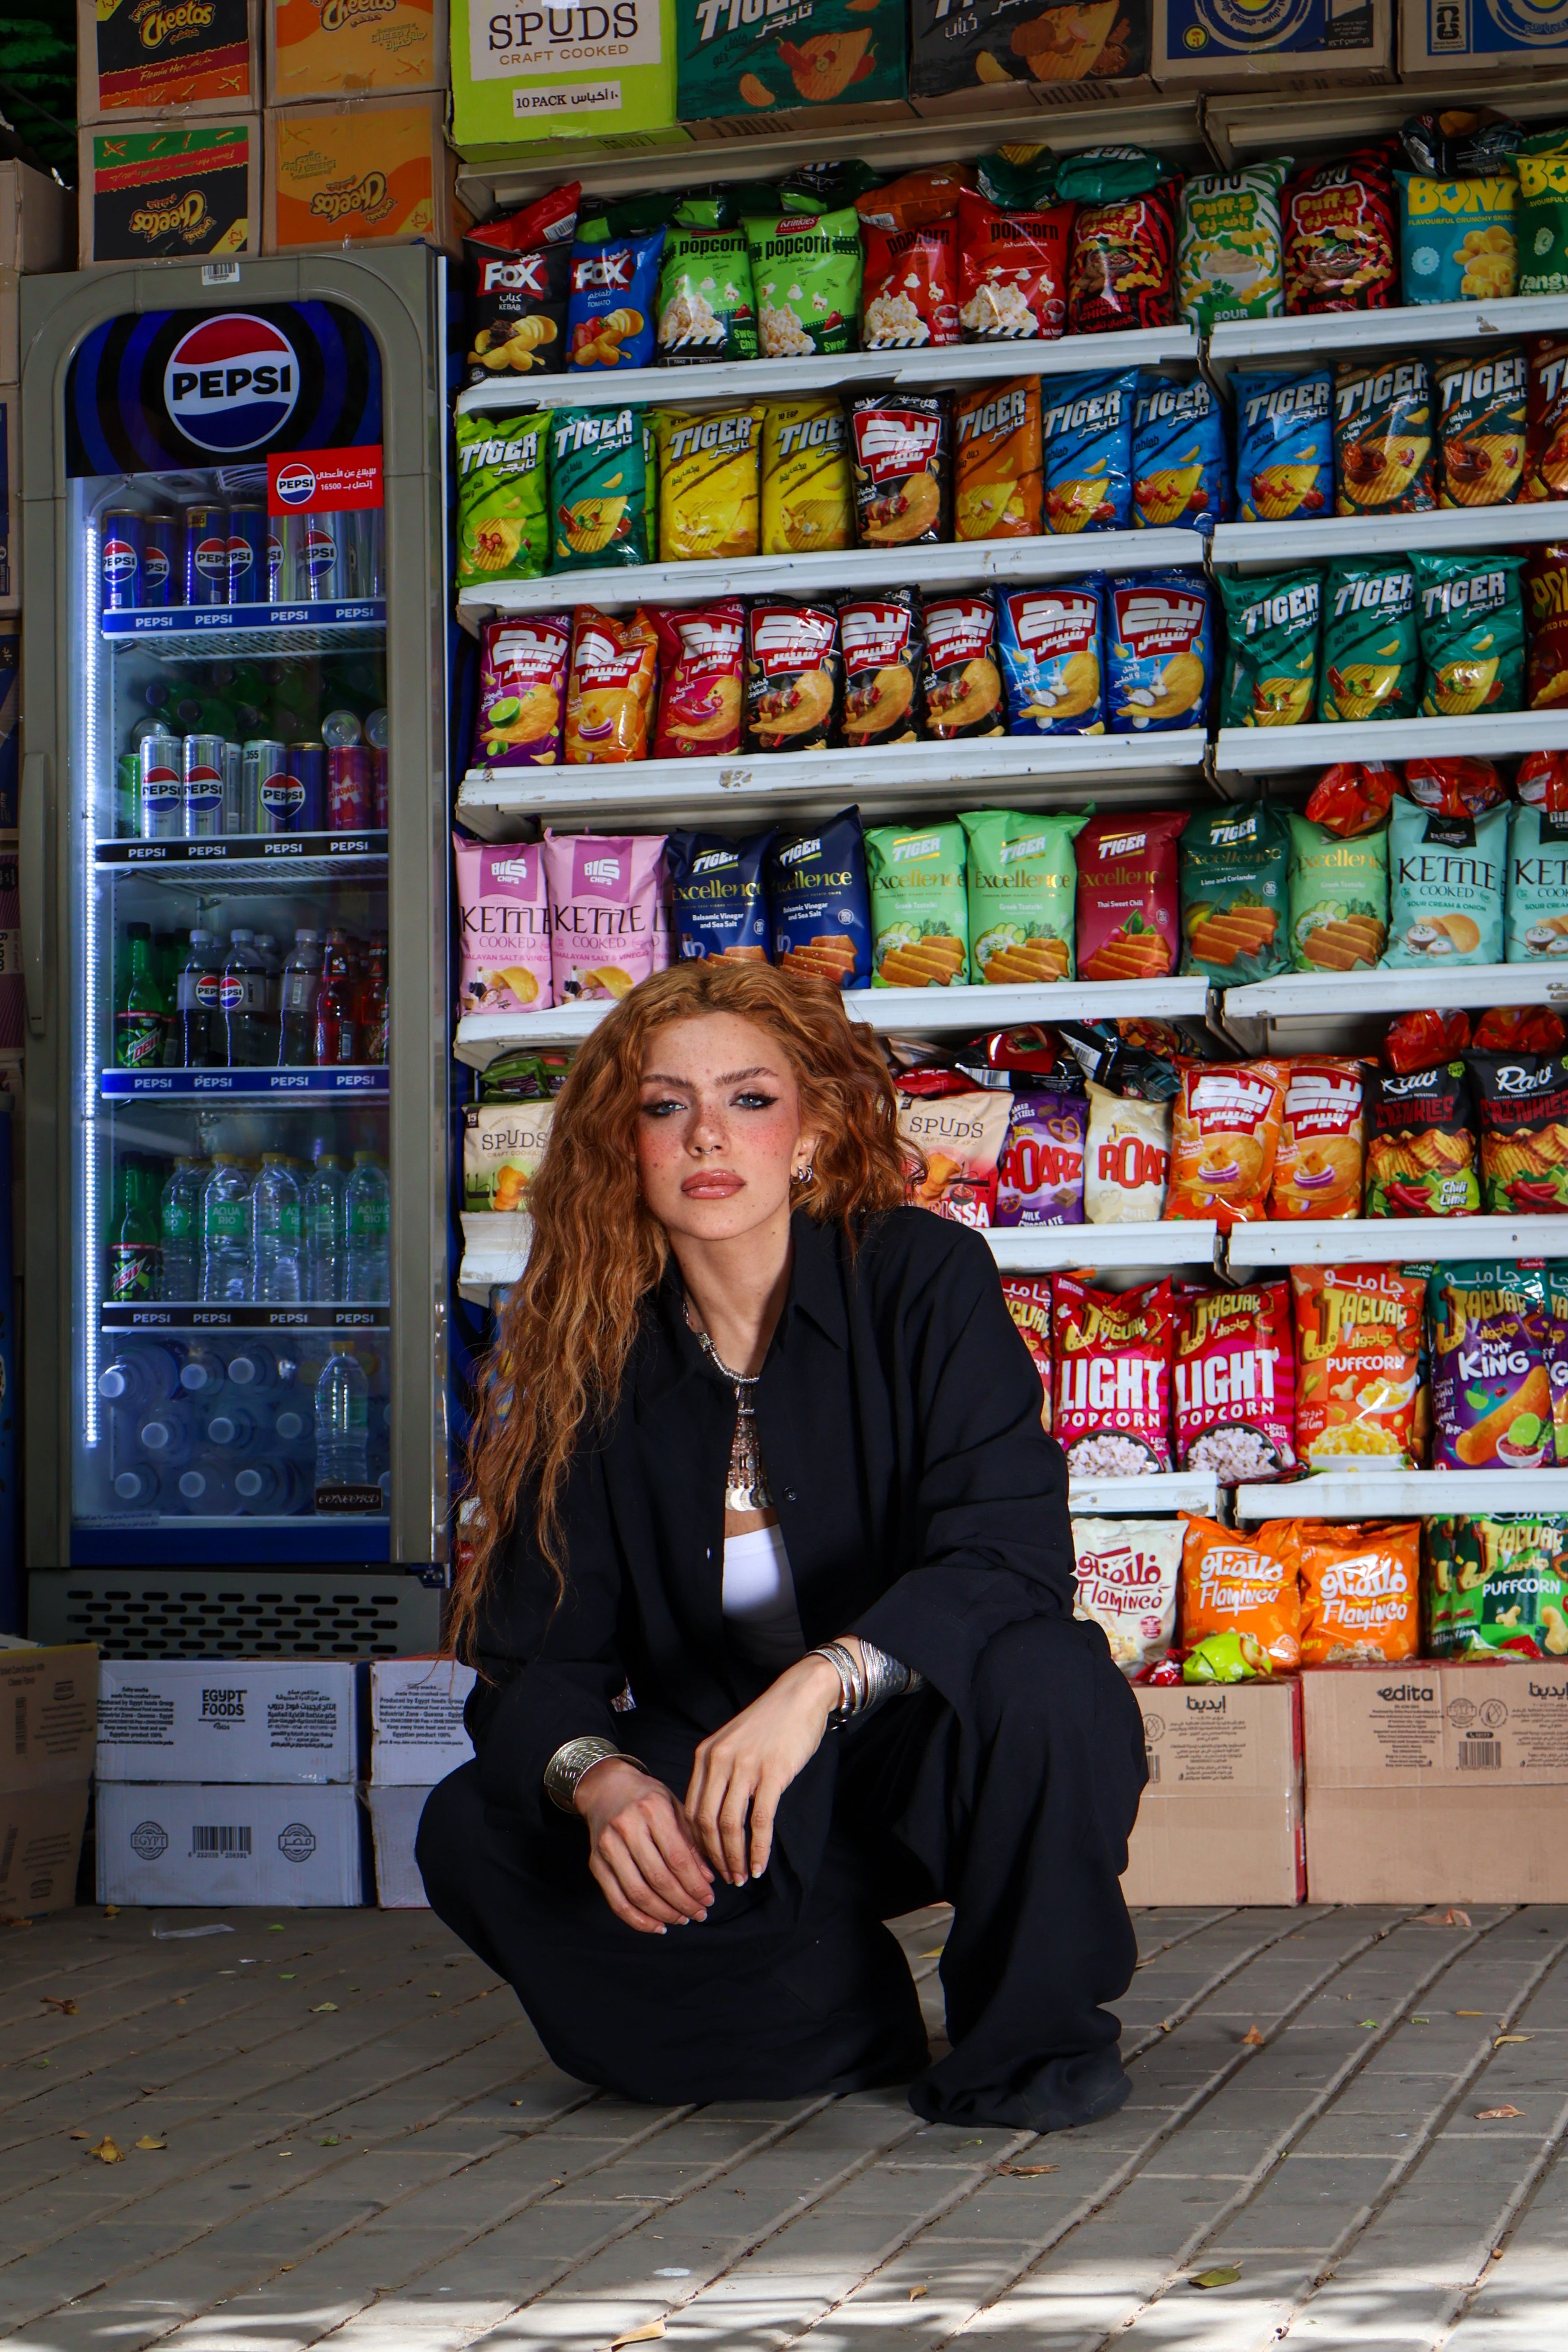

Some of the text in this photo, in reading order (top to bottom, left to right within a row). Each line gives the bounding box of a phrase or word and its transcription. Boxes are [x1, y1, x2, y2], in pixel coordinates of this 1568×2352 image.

[140, 1, 215, 49] Cheetos
[489, 2, 639, 50] SPUDS
[499, 44, 629, 66] CRAFT COOKED
[516, 95, 567, 108] 10 PACK
[310, 172, 387, 224] Cheetos
[129, 190, 208, 242] Cheetos
[1408, 217, 1455, 225] FLAVOURFUL
[886, 228, 950, 256] popcorn
[991, 220, 1058, 243] popcorn
[681, 237, 747, 256] popcorn
[765, 235, 830, 260] popcorn
[484, 259, 543, 291] FOX
[575, 259, 631, 290] FOX
[499, 293, 522, 302] كباب
[1214, 308, 1249, 322] SOUR
[173, 365, 291, 401] PEPSI
[1044, 389, 1122, 440] TIGER
[1134, 381, 1210, 428] TIGER
[1245, 382, 1329, 428] TIGER
[956, 389, 1027, 444] TIGER
[555, 409, 633, 459] TIGER
[670, 414, 753, 460] TIGER
[778, 416, 845, 457] TIGE
[461, 431, 538, 476] TIGER
[279, 479, 313, 489] PEPSI
[1334, 574, 1414, 617] TIGER
[1423, 571, 1505, 619] TIGER
[136, 608, 373, 627] PEPSI PEPSI PEPSI PEPSI
[1241, 583, 1319, 635] TIGER
[142, 785, 180, 795] PEPSI
[1210, 818, 1257, 846] TIGER
[128, 841, 368, 858] PEPSI PEPSI PEPSI PEPSI
[780, 837, 821, 867] TIGER
[893, 837, 941, 862] TIGER
[1000, 836, 1046, 865] TIGER
[1098, 833, 1146, 859] TIGER
[491, 858, 527, 880] BIG
[584, 859, 620, 880] BIG
[976, 869, 1071, 888] Excellence
[1227, 874, 1257, 883] Coriander
[1398, 856, 1496, 891] KETTLE
[497, 876, 520, 885] CHIPS
[590, 876, 612, 885] CHIPS
[873, 869, 964, 892] Excellence
[1421, 885, 1474, 898] COOKED
[720, 913, 744, 921] Vinegar
[783, 902, 828, 914] Balsamic Vinegar
[1462, 903, 1487, 912] ONION
[461, 906, 551, 934] KETTLE
[554, 904, 646, 934] KETTLE
[479, 936, 536, 948] COOKED
[572, 935, 626, 949] COOKED
[619, 950, 649, 960] VINEGAR
[134, 1076, 374, 1088] PEPSI PEPSI PEPSI PEPSI
[1496, 1065, 1553, 1093] Raw
[467, 1113, 476, 1123] 15
[1375, 1096, 1454, 1128] CRINKLES
[909, 1117, 984, 1138] SPUDS
[482, 1130, 547, 1150] SPUDS
[1001, 1139, 1083, 1194] ROARZ
[1442, 1181, 1467, 1194] Chili
[1440, 1193, 1468, 1206] Lime
[212, 1206, 240, 1216] AQUA
[218, 1216, 235, 1225] RIO
[1022, 1210, 1040, 1221] MILK
[133, 1314, 374, 1323] PEPSI PEPSI PEPSI PEPSI
[1301, 1287, 1408, 1365] JAGUAR
[1435, 1285, 1527, 1356] JAGUAR
[1481, 1342, 1511, 1354] PUFF
[1326, 1355, 1406, 1372] PUFFCORN
[1457, 1350, 1529, 1382] KING
[1061, 1357, 1165, 1411] LIGHT
[1175, 1346, 1280, 1412] LIGHT
[1061, 1412, 1160, 1428] POPCORN
[1179, 1401, 1274, 1429] POPCORN
[1264, 1423, 1286, 1433] LIGHT
[1482, 1577, 1561, 1597] PUFFCORN
[202, 1689, 243, 1703] EGYPT
[1376, 1684, 1433, 1701] edita
[202, 1703, 244, 1716] FOODS
[134, 1836, 165, 1847] EGYPT
